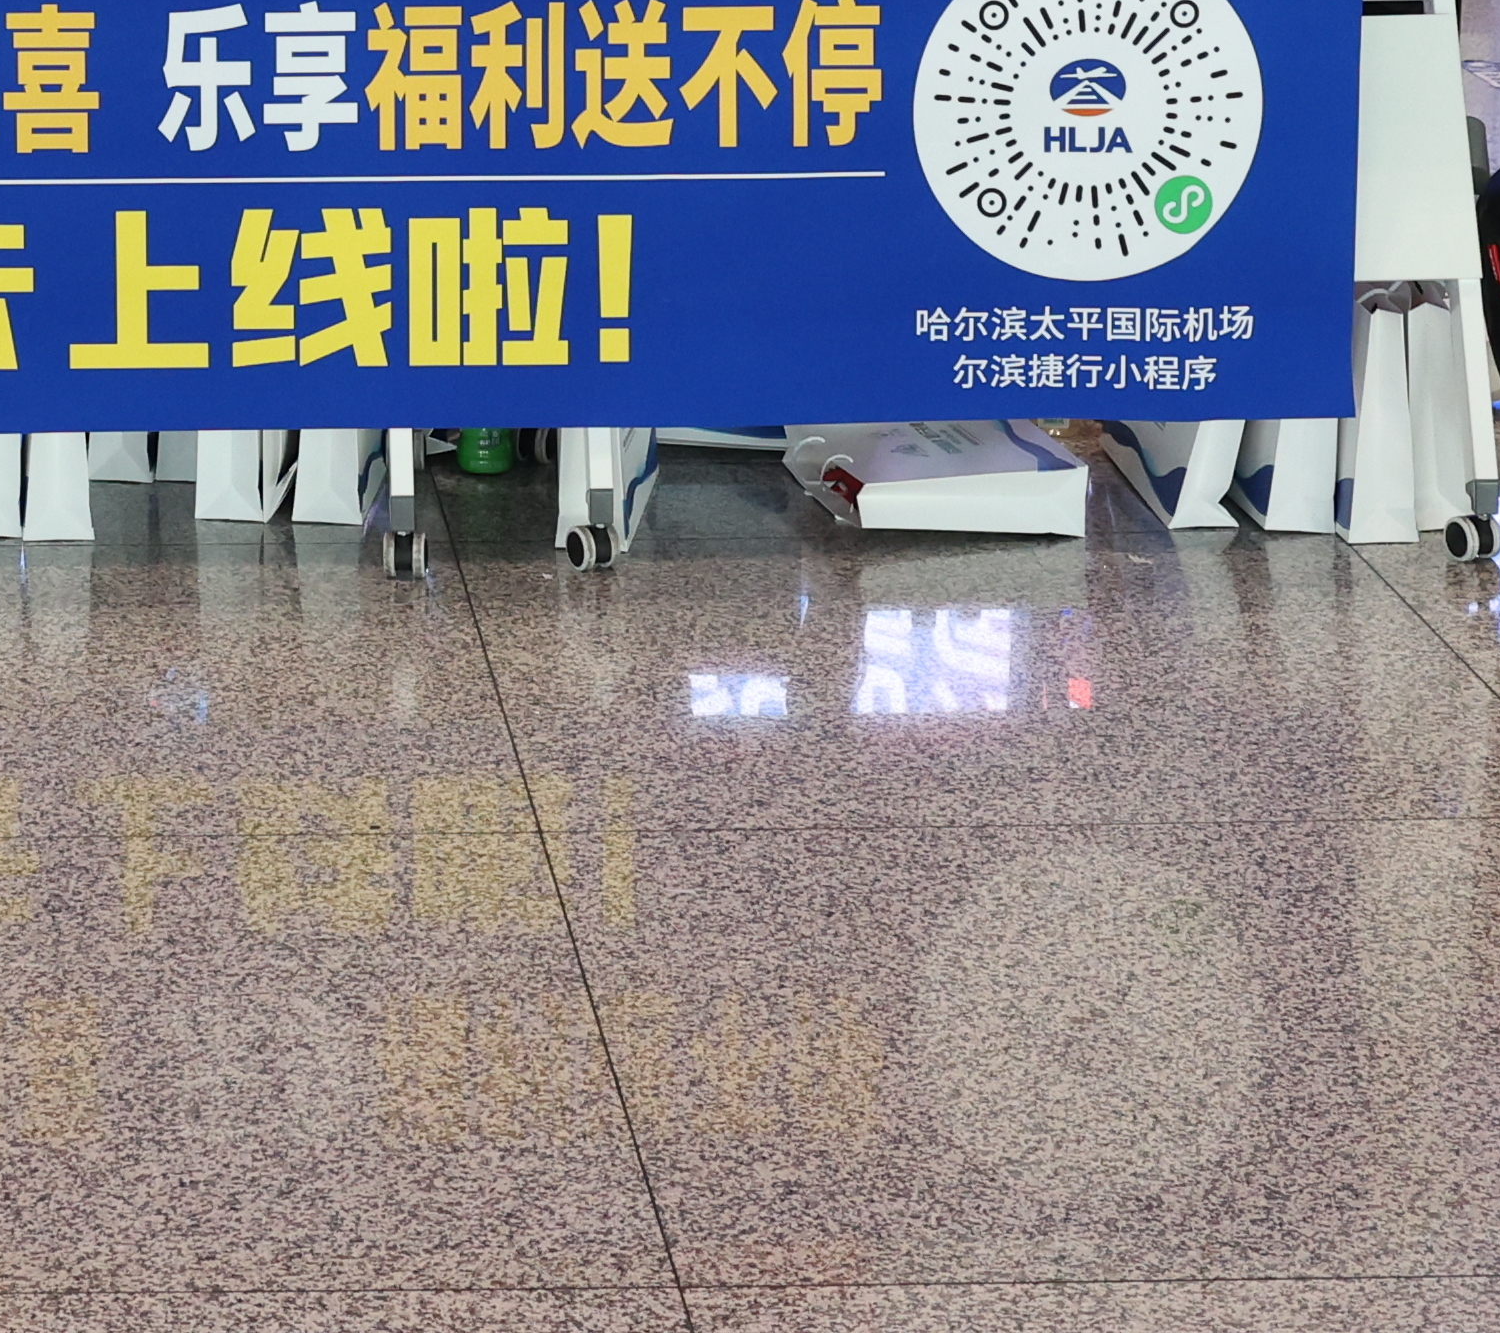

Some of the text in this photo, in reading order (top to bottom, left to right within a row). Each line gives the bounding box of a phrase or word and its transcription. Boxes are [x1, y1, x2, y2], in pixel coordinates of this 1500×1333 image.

[1041, 124, 1135, 156] HLJA
[914, 304, 1256, 346] 哈尔滨太平国际机场
[950, 349, 1219, 395] 尔滨捷行小程序
